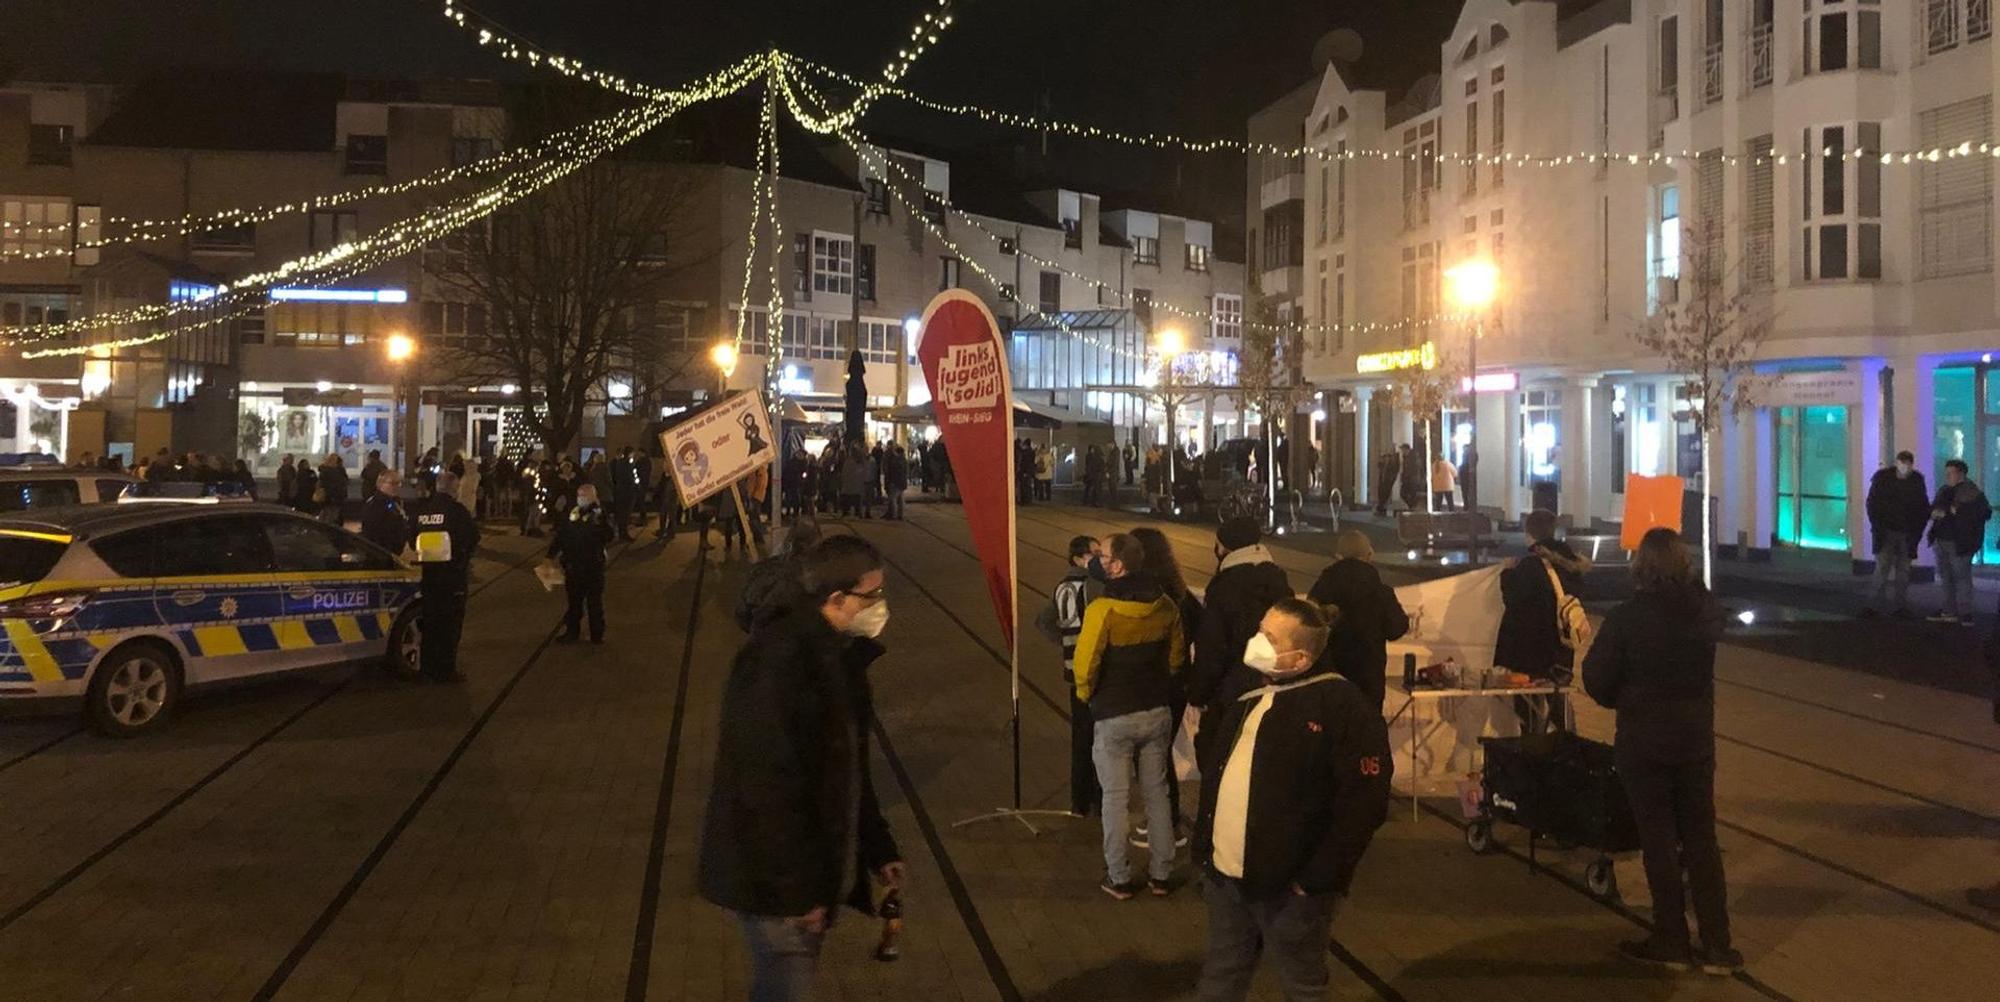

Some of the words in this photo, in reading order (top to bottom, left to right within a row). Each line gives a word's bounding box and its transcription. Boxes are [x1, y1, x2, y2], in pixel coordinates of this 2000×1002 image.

[956, 346, 989, 367] links
[941, 356, 995, 391] jugend
[712, 433, 730, 449] oder
[418, 513, 444, 525] POLIZEI
[313, 590, 369, 609] POLIZEI
